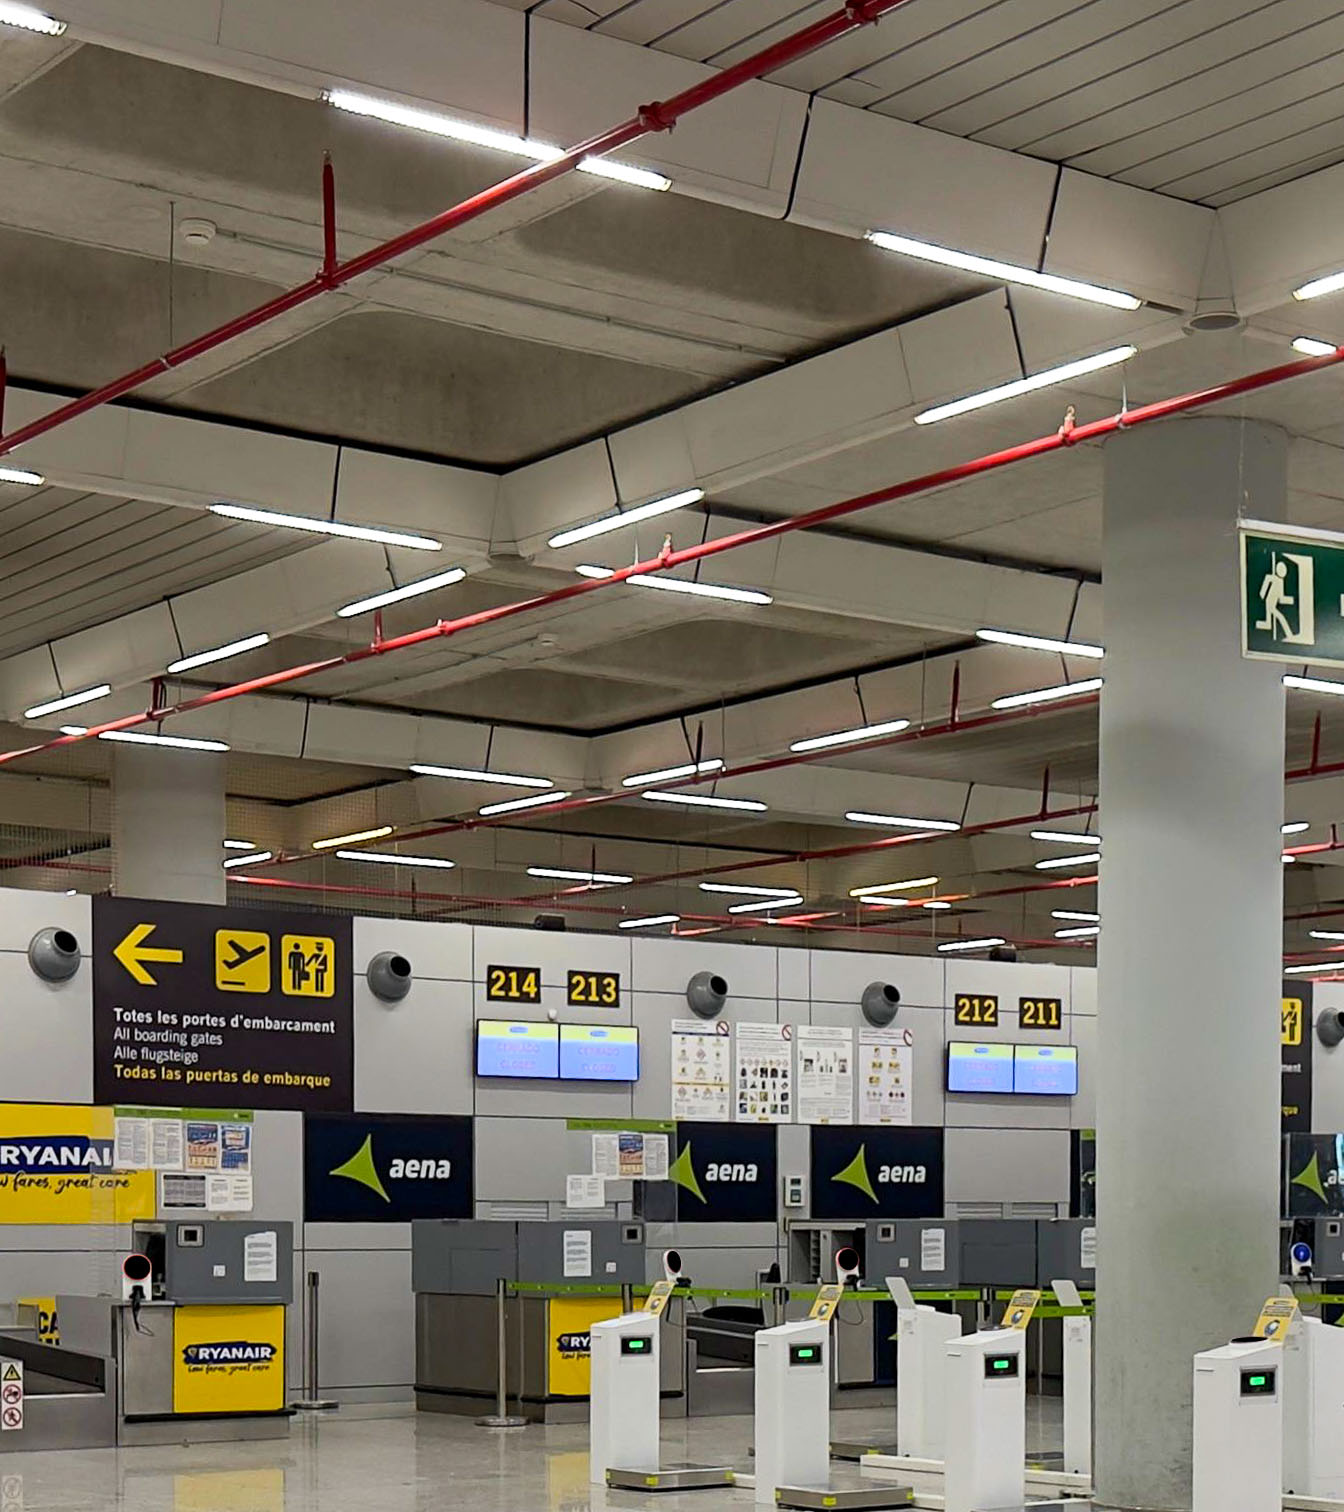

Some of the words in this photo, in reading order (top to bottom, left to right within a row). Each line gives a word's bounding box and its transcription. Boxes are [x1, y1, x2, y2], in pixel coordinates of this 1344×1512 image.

[490, 969, 537, 998] 214
[571, 975, 617, 1003] 213
[114, 1008, 152, 1024] Totes
[157, 1010, 178, 1024] les
[182, 1013, 226, 1029] portes
[230, 1015, 335, 1034] d'embarcament
[958, 998, 995, 1022] 212
[1023, 1001, 1059, 1025] 211
[114, 1027, 130, 1041] All
[134, 1028, 188, 1047] boarding
[191, 1031, 223, 1047] gates
[114, 1046, 138, 1060] Alle
[141, 1047, 199, 1065] flugsteige
[114, 1064, 157, 1079] Todas
[161, 1066, 182, 1080] las
[186, 1068, 238, 1084] puertas
[242, 1070, 259, 1084] de
[264, 1071, 331, 1089] embarque
[0, 1144, 113, 1166] RYANAI
[389, 1158, 451, 1179] aena
[705, 1163, 758, 1182] aena
[878, 1165, 926, 1183] aena
[13, 1170, 52, 1192] fares,
[54, 1175, 95, 1194] great
[199, 1346, 272, 1360] RYANAIR
